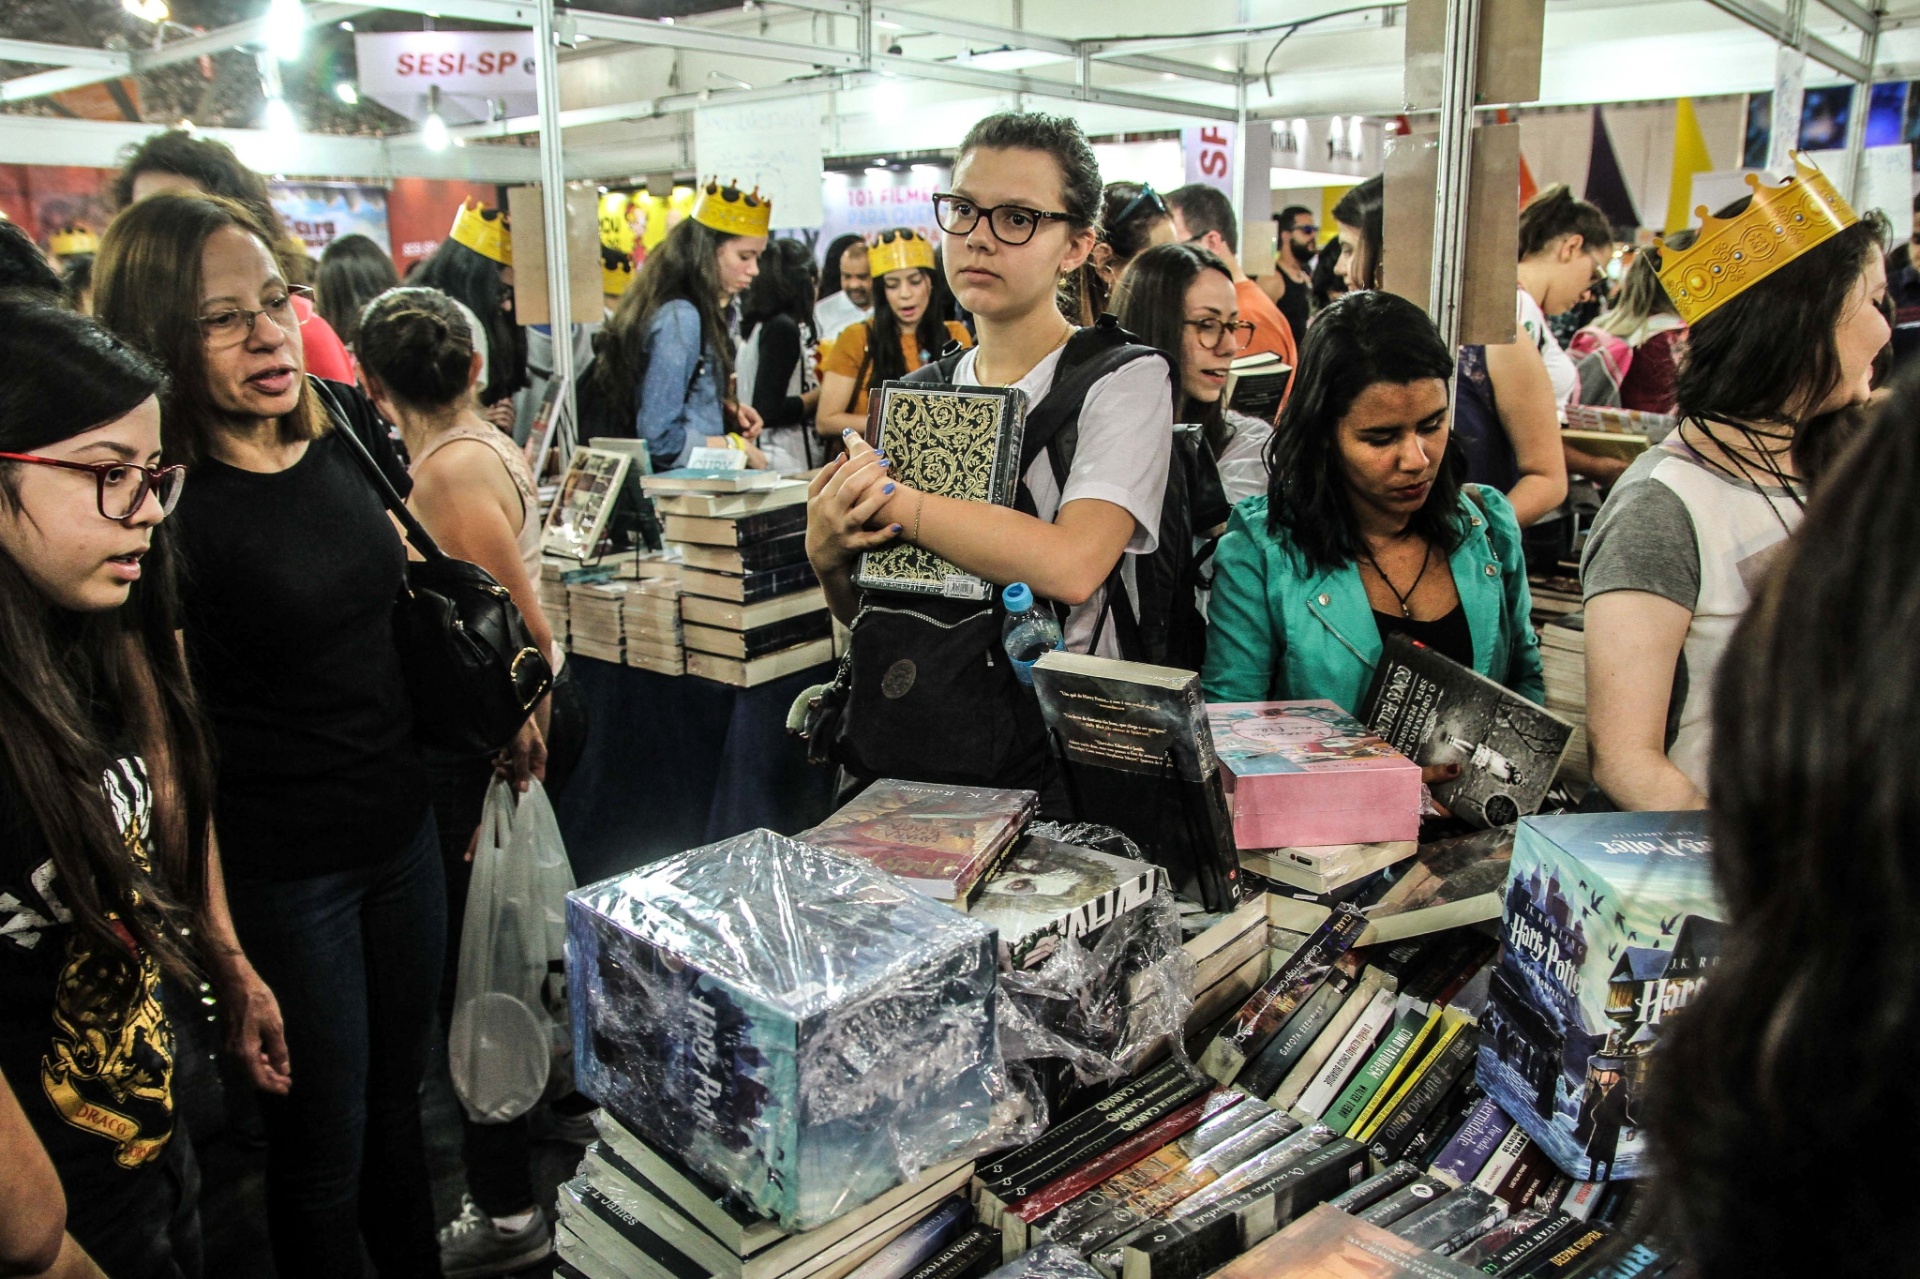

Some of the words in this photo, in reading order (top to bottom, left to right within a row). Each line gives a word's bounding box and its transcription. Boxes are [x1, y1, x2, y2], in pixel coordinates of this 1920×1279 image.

[397, 51, 517, 76] SESI-SP
[848, 189, 873, 207] 101
[1427, 682, 1436, 692] O
[1405, 693, 1435, 743] ORFANATO
[896, 784, 955, 796] Rowling
[1594, 837, 1686, 856] Potter
[1332, 912, 1352, 933] CLARE
[1300, 942, 1322, 965] Cidade
[1510, 912, 1547, 962] Harry
[1545, 936, 1589, 999] Potter
[1278, 1030, 1302, 1057] GAROTA
[1355, 1026, 1371, 1043] IRMÃO
[1391, 1026, 1413, 1049] COMO
[1344, 1037, 1363, 1057] ALEMÃO
[1336, 1052, 1351, 1068] CHICO
[1365, 1040, 1401, 1081] TATUAGEM
[1322, 1064, 1343, 1087] BUARQUE
[1094, 1082, 1135, 1114] CARVÃO
[1349, 1083, 1368, 1103] WALTER
[76, 1104, 127, 1137] DRACO
[1104, 1093, 1145, 1125] CARVÃO
[1119, 1102, 1160, 1134] CARVÃO
[1383, 1108, 1412, 1141] REINO
[1485, 1123, 1502, 1140] Por
[1476, 1134, 1494, 1153] toda
[1500, 1130, 1520, 1153] QUANDO
[1509, 1135, 1527, 1157] FORAM
[1082, 1148, 1169, 1216] INFERNO
[582, 1184, 592, 1192] E
[601, 1198, 638, 1226] James
[1238, 1191, 1252, 1204] de
[1189, 1190, 1241, 1230] tempestade
[1531, 1210, 1570, 1246] GILLIAN
[948, 1230, 981, 1256] PROVA
[1500, 1235, 1533, 1266] FLYNN
[1548, 1240, 1580, 1270] DEEPAK
[1573, 1225, 1604, 1253] CHOPRA
[937, 1250, 953, 1265] DE
[1360, 1240, 1410, 1269] CRÔNICAS
[1411, 1266, 1425, 1277] DE
